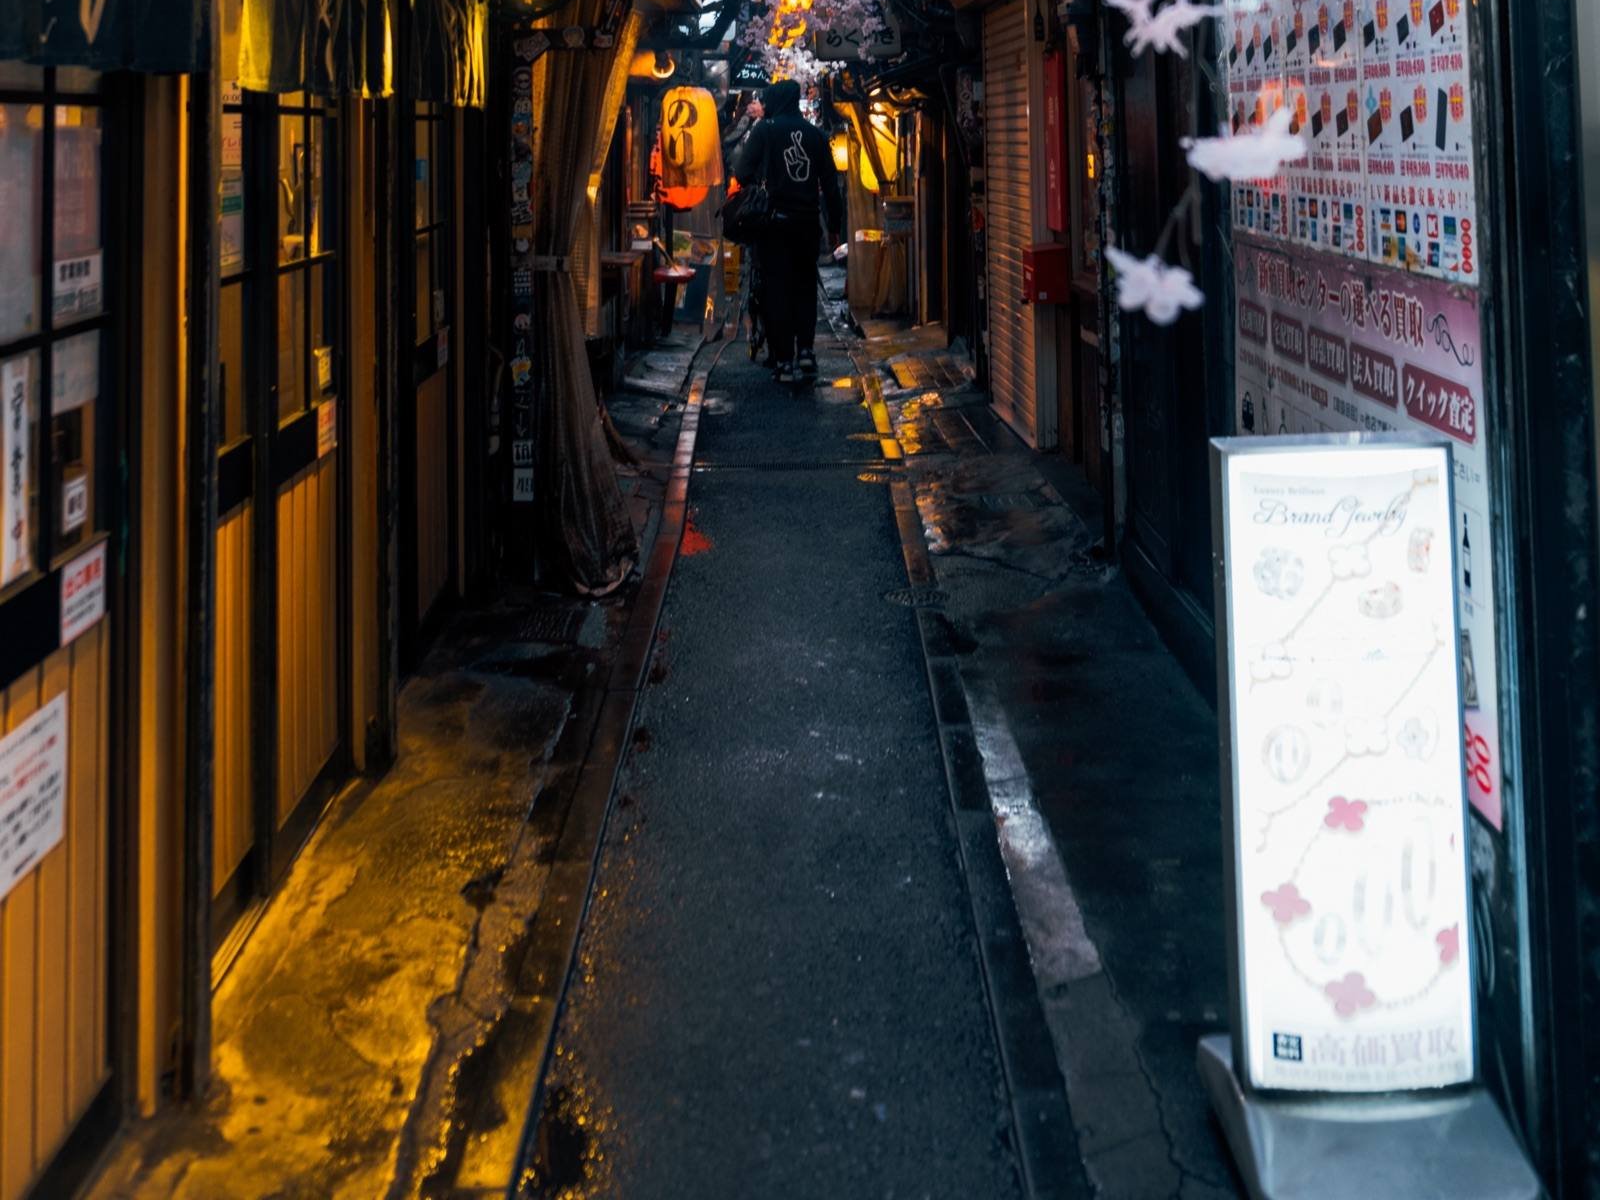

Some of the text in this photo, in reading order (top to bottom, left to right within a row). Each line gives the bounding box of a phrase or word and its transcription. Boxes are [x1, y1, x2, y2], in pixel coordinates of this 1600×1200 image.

[1352, 355, 1395, 399] 法人買取
[1406, 375, 1474, 436] クイック査定
[1253, 496, 1341, 525] Brand
